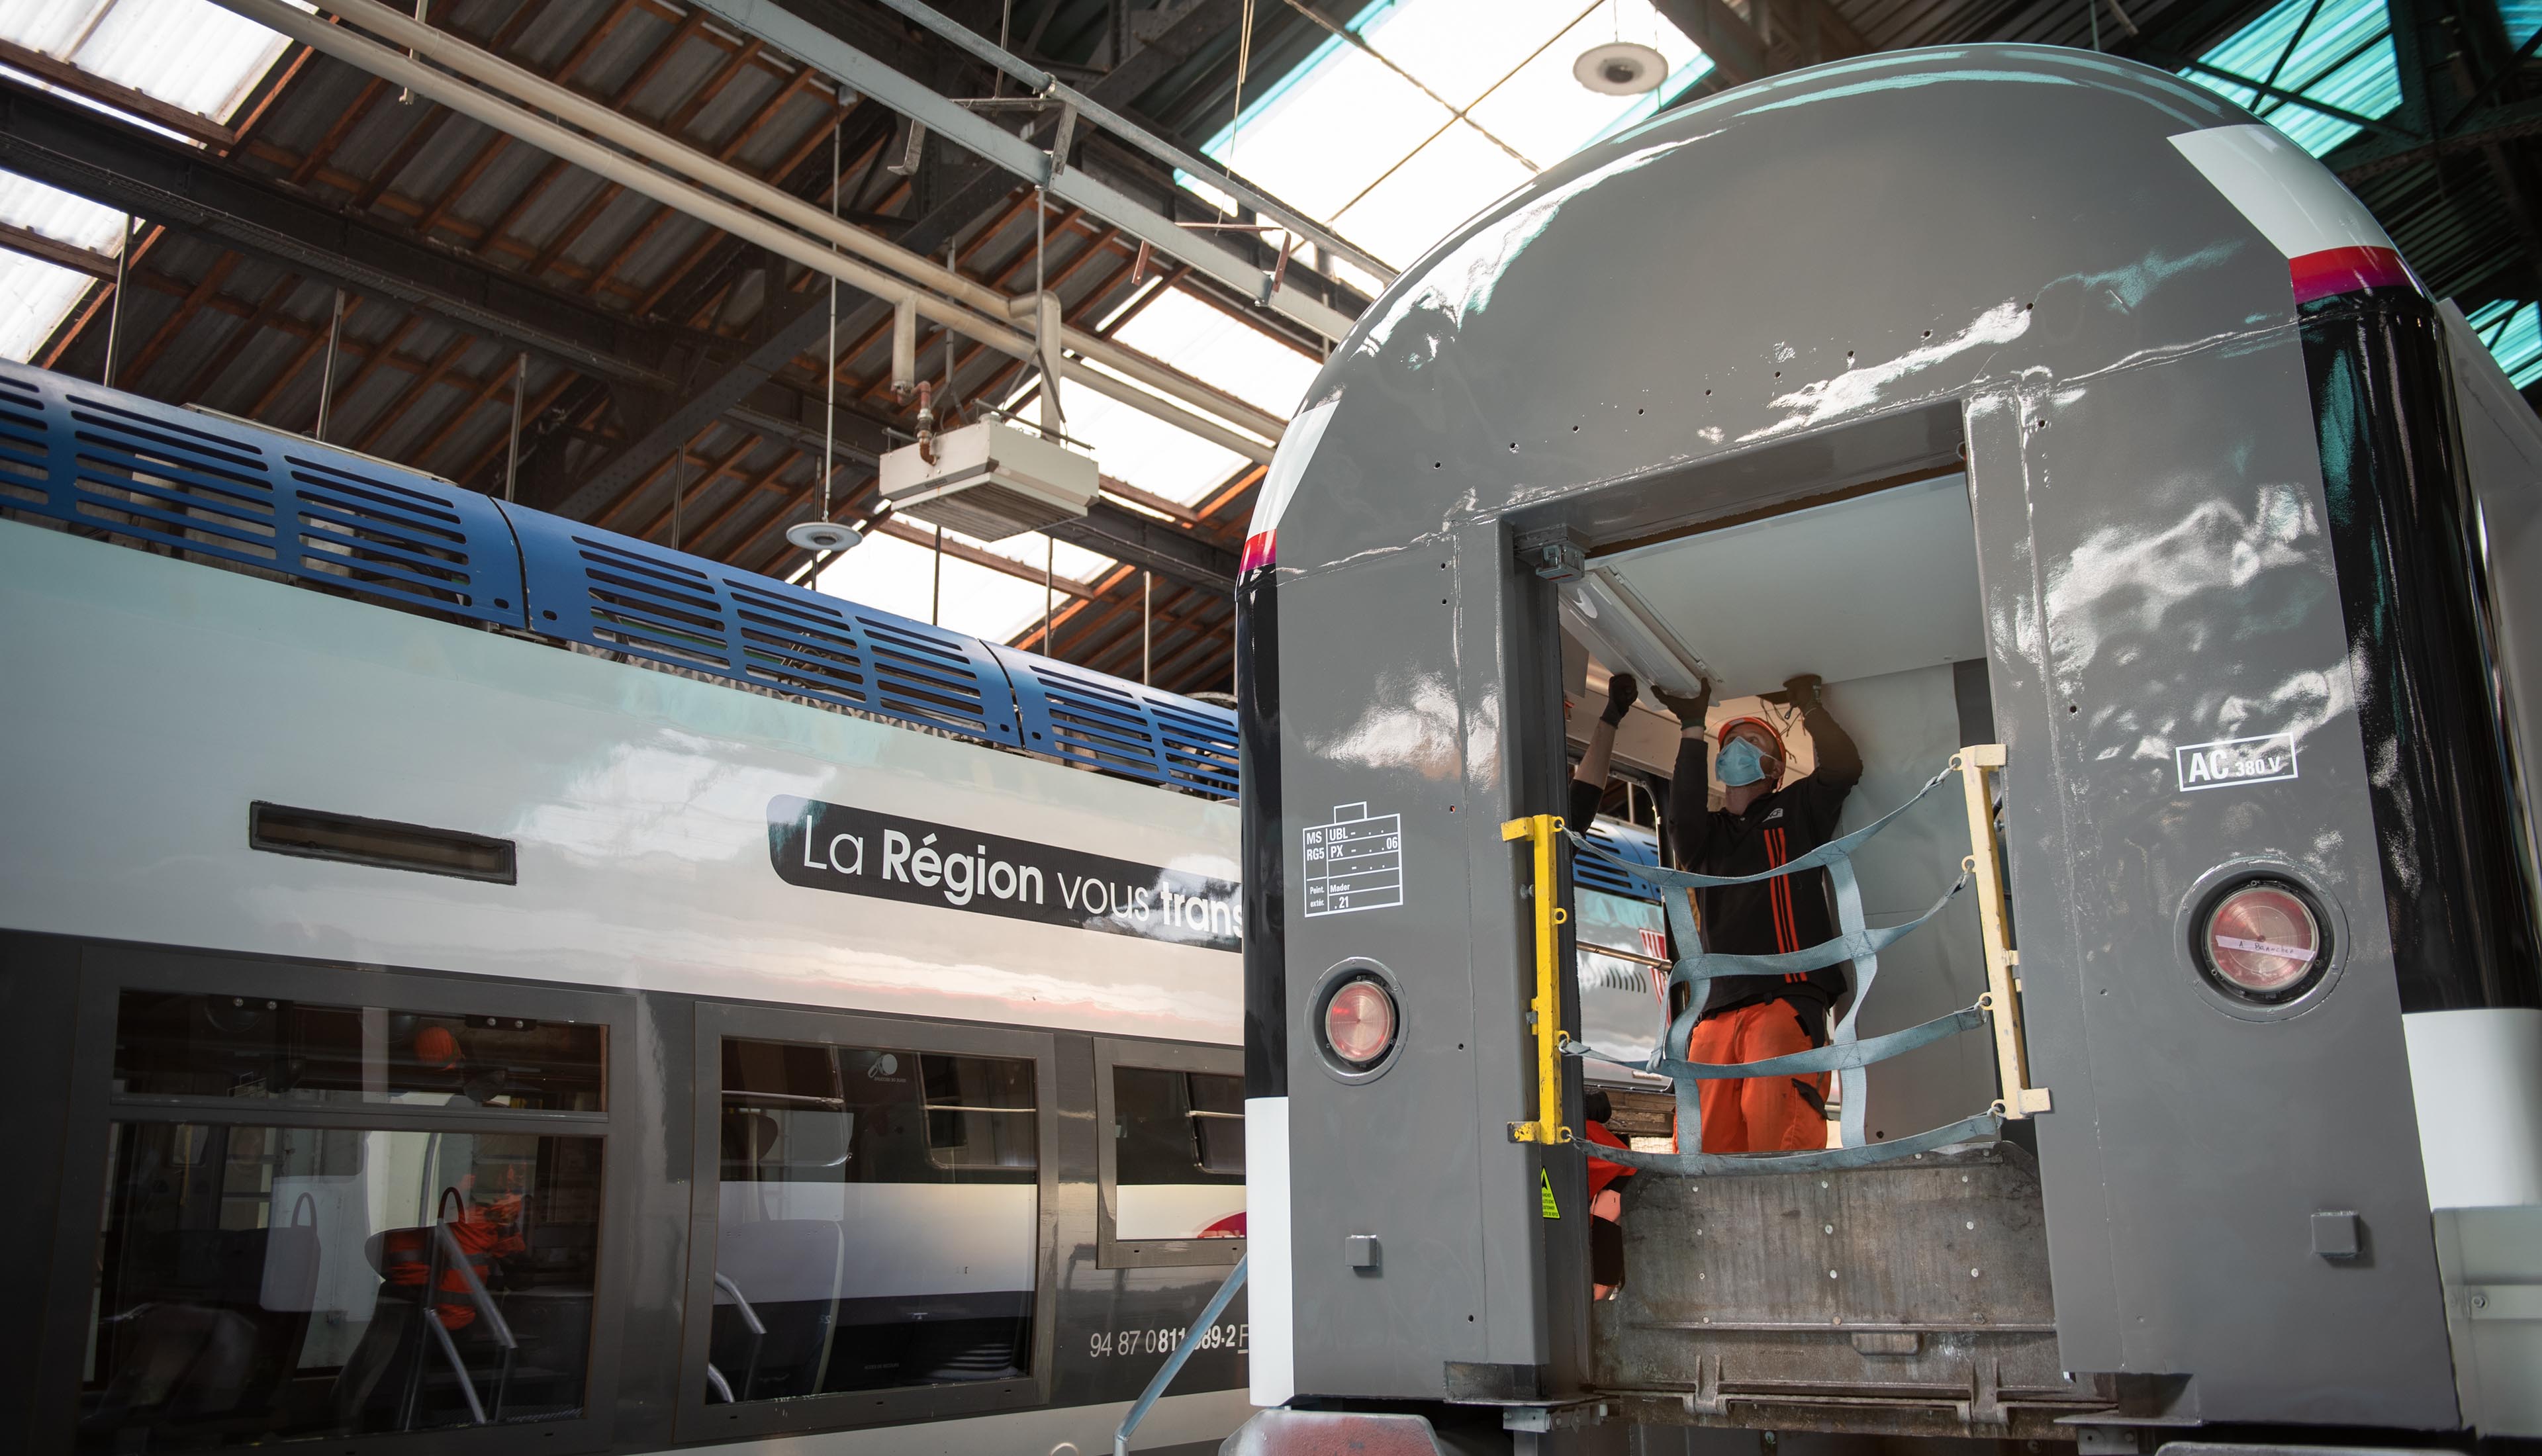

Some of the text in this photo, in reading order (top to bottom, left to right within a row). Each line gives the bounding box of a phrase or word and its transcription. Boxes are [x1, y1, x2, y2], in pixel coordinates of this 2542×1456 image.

[2189, 750, 2281, 783] AC 380 V
[1306, 827, 1348, 845] MS UBL
[1306, 847, 1325, 861] RG5
[1331, 844, 1343, 858] PX
[803, 815, 863, 876] La
[882, 829, 1044, 906] Région
[1057, 872, 1150, 922] vous
[1090, 1332, 1112, 1357] 94
[1117, 1330, 1141, 1355] 87
